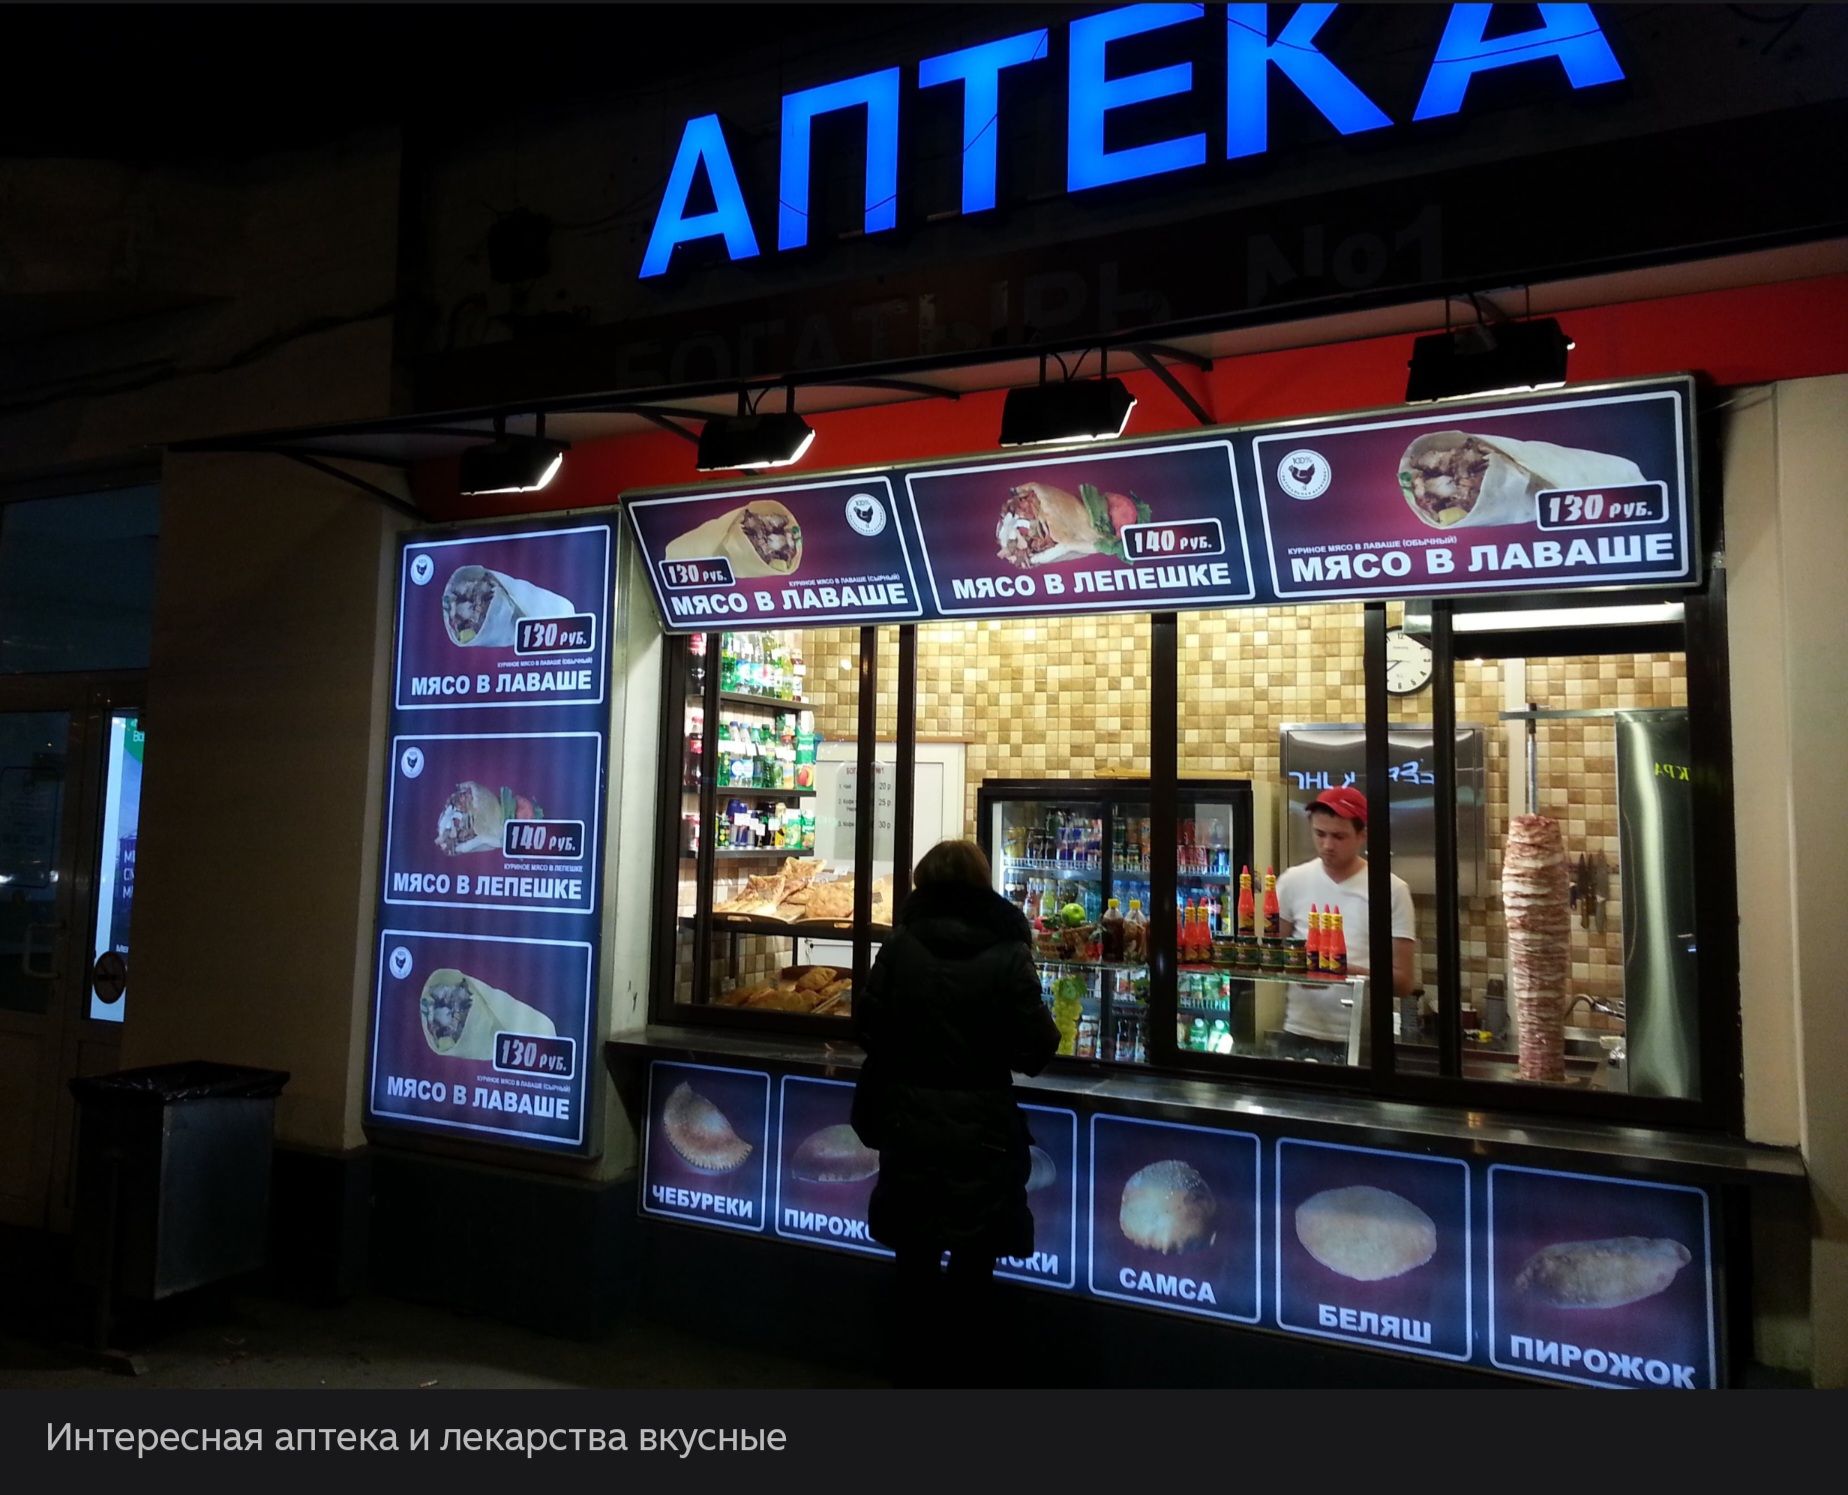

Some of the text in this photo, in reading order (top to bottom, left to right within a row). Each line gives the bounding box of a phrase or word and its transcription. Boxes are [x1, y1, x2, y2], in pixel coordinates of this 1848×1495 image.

[639, 3, 1625, 279] АПТЕКА
[1549, 494, 1653, 522] 130 РУБ.
[1134, 530, 1212, 553] 140 РУБ.
[1288, 546, 1326, 555] КУРИНОЕ
[1328, 544, 1353, 552] МЯСО
[1364, 540, 1400, 550] ЛАВАШЕ
[1402, 536, 1457, 547] (ОБЫЧНЫЙ)
[1291, 533, 1674, 582] МЯСО В ЛАВАШЕ
[668, 564, 727, 583] 130 РУБ.
[952, 562, 1231, 600] МЯСО В ЛЕПЕШКЕ
[671, 583, 908, 615] МЯСО В ЛАВАШЕ
[524, 623, 586, 648] 130 РУБ.
[411, 670, 592, 696] МЯСО В ЛАВАШЕ
[511, 825, 576, 851] 140 РУБ.
[393, 872, 582, 900] МЯСО В ЛЕПЕШКЕ
[502, 1039, 566, 1071] 130 РУБ.
[387, 1076, 569, 1120] МЯСО В ЛАВАШЕ
[652, 1184, 752, 1219] ЧЕБУРЕКИ
[784, 1208, 876, 1242] ПИРОЖ
[1119, 1267, 1217, 1304] САМСА
[1318, 1304, 1432, 1345] БЕЛЯШ
[1510, 1335, 1696, 1389] ПИРОЖОК
